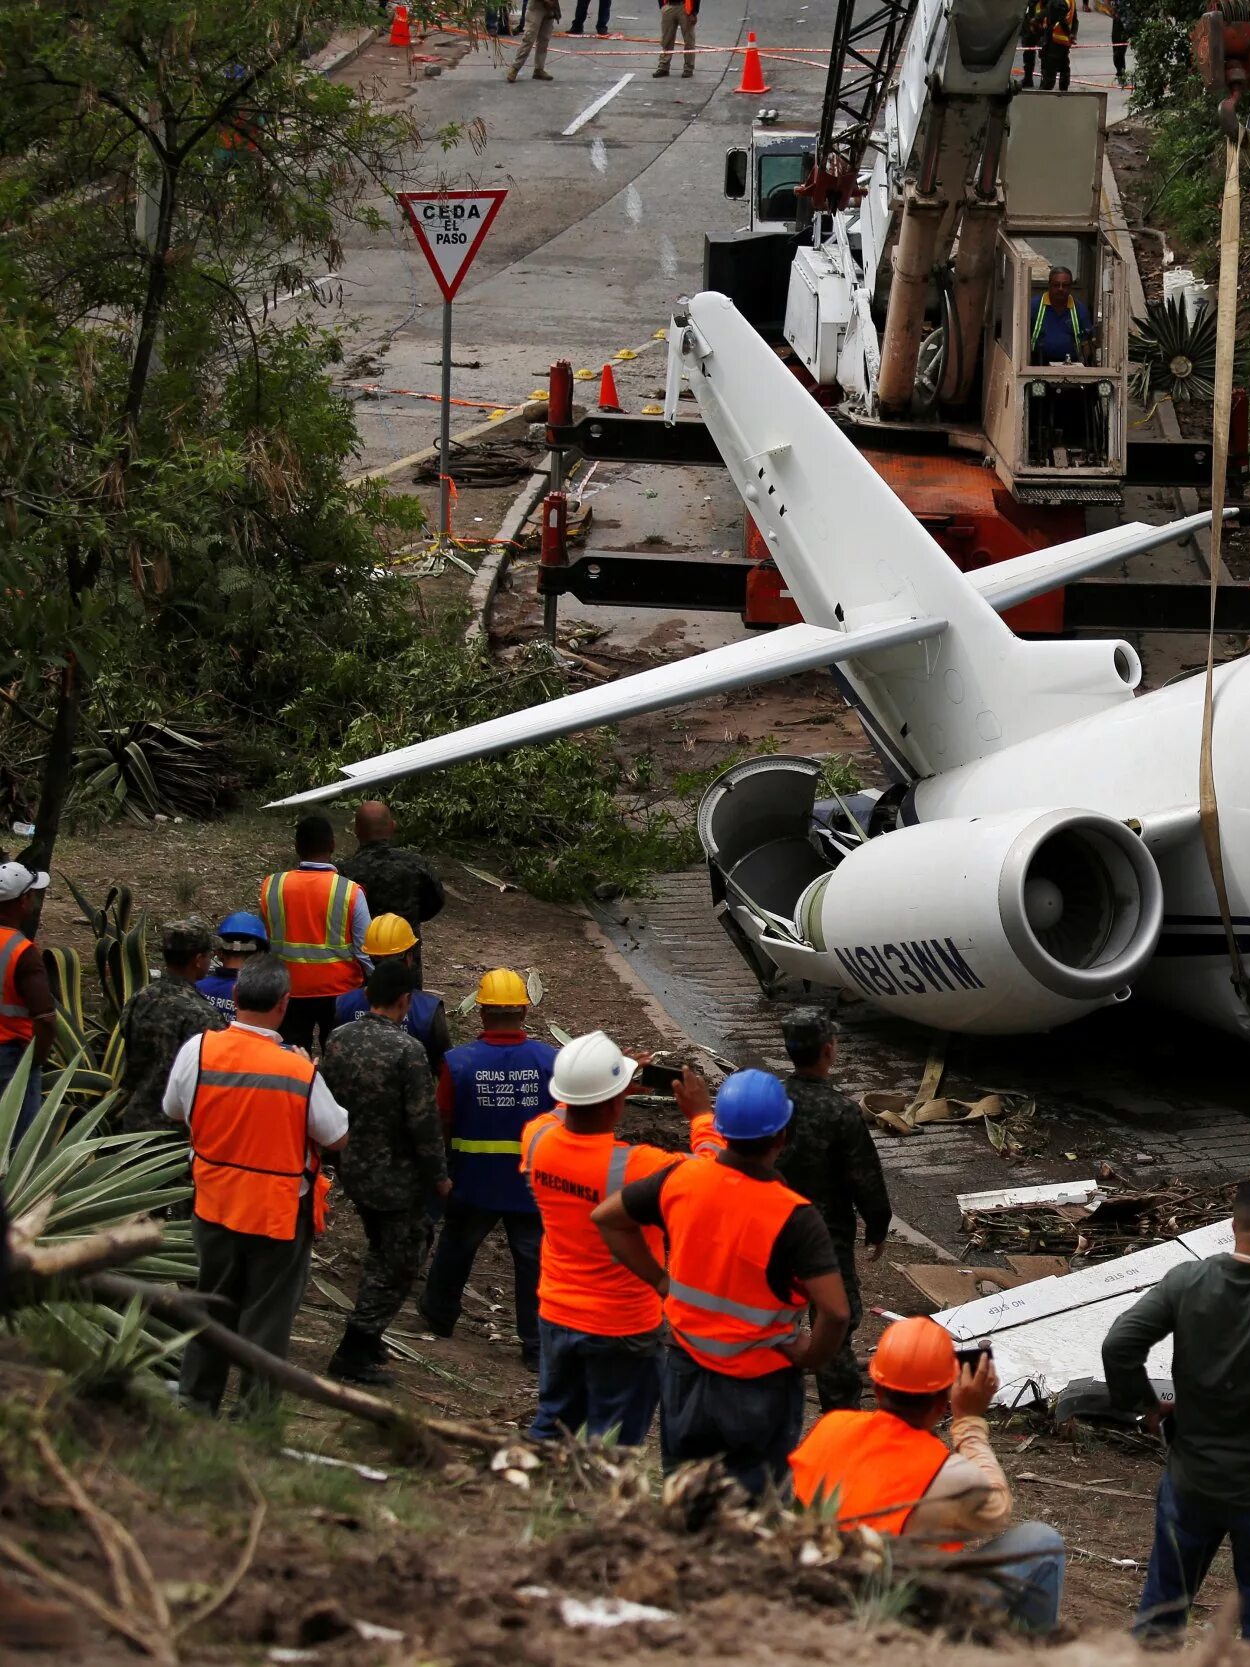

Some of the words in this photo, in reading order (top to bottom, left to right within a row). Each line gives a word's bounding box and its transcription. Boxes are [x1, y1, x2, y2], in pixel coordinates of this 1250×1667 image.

[423, 205, 480, 219] CEDA
[445, 220, 459, 231] EL
[436, 233, 467, 244] PASO
[834, 938, 986, 996] N813WM
[476, 1071, 505, 1081] GRUAS
[509, 1070, 539, 1081] RIVERA
[476, 1084, 494, 1094] TEL:
[496, 1084, 514, 1093] 2222
[521, 1083, 538, 1093] 4015
[477, 1097, 495, 1106] TEL:
[497, 1097, 515, 1106] 2220
[521, 1096, 539, 1106] 4093
[1105, 1272, 1125, 1283] STEP
[1126, 1268, 1139, 1276] NO
[989, 1304, 1010, 1315] STEP
[1161, 1392, 1174, 1401] NO
